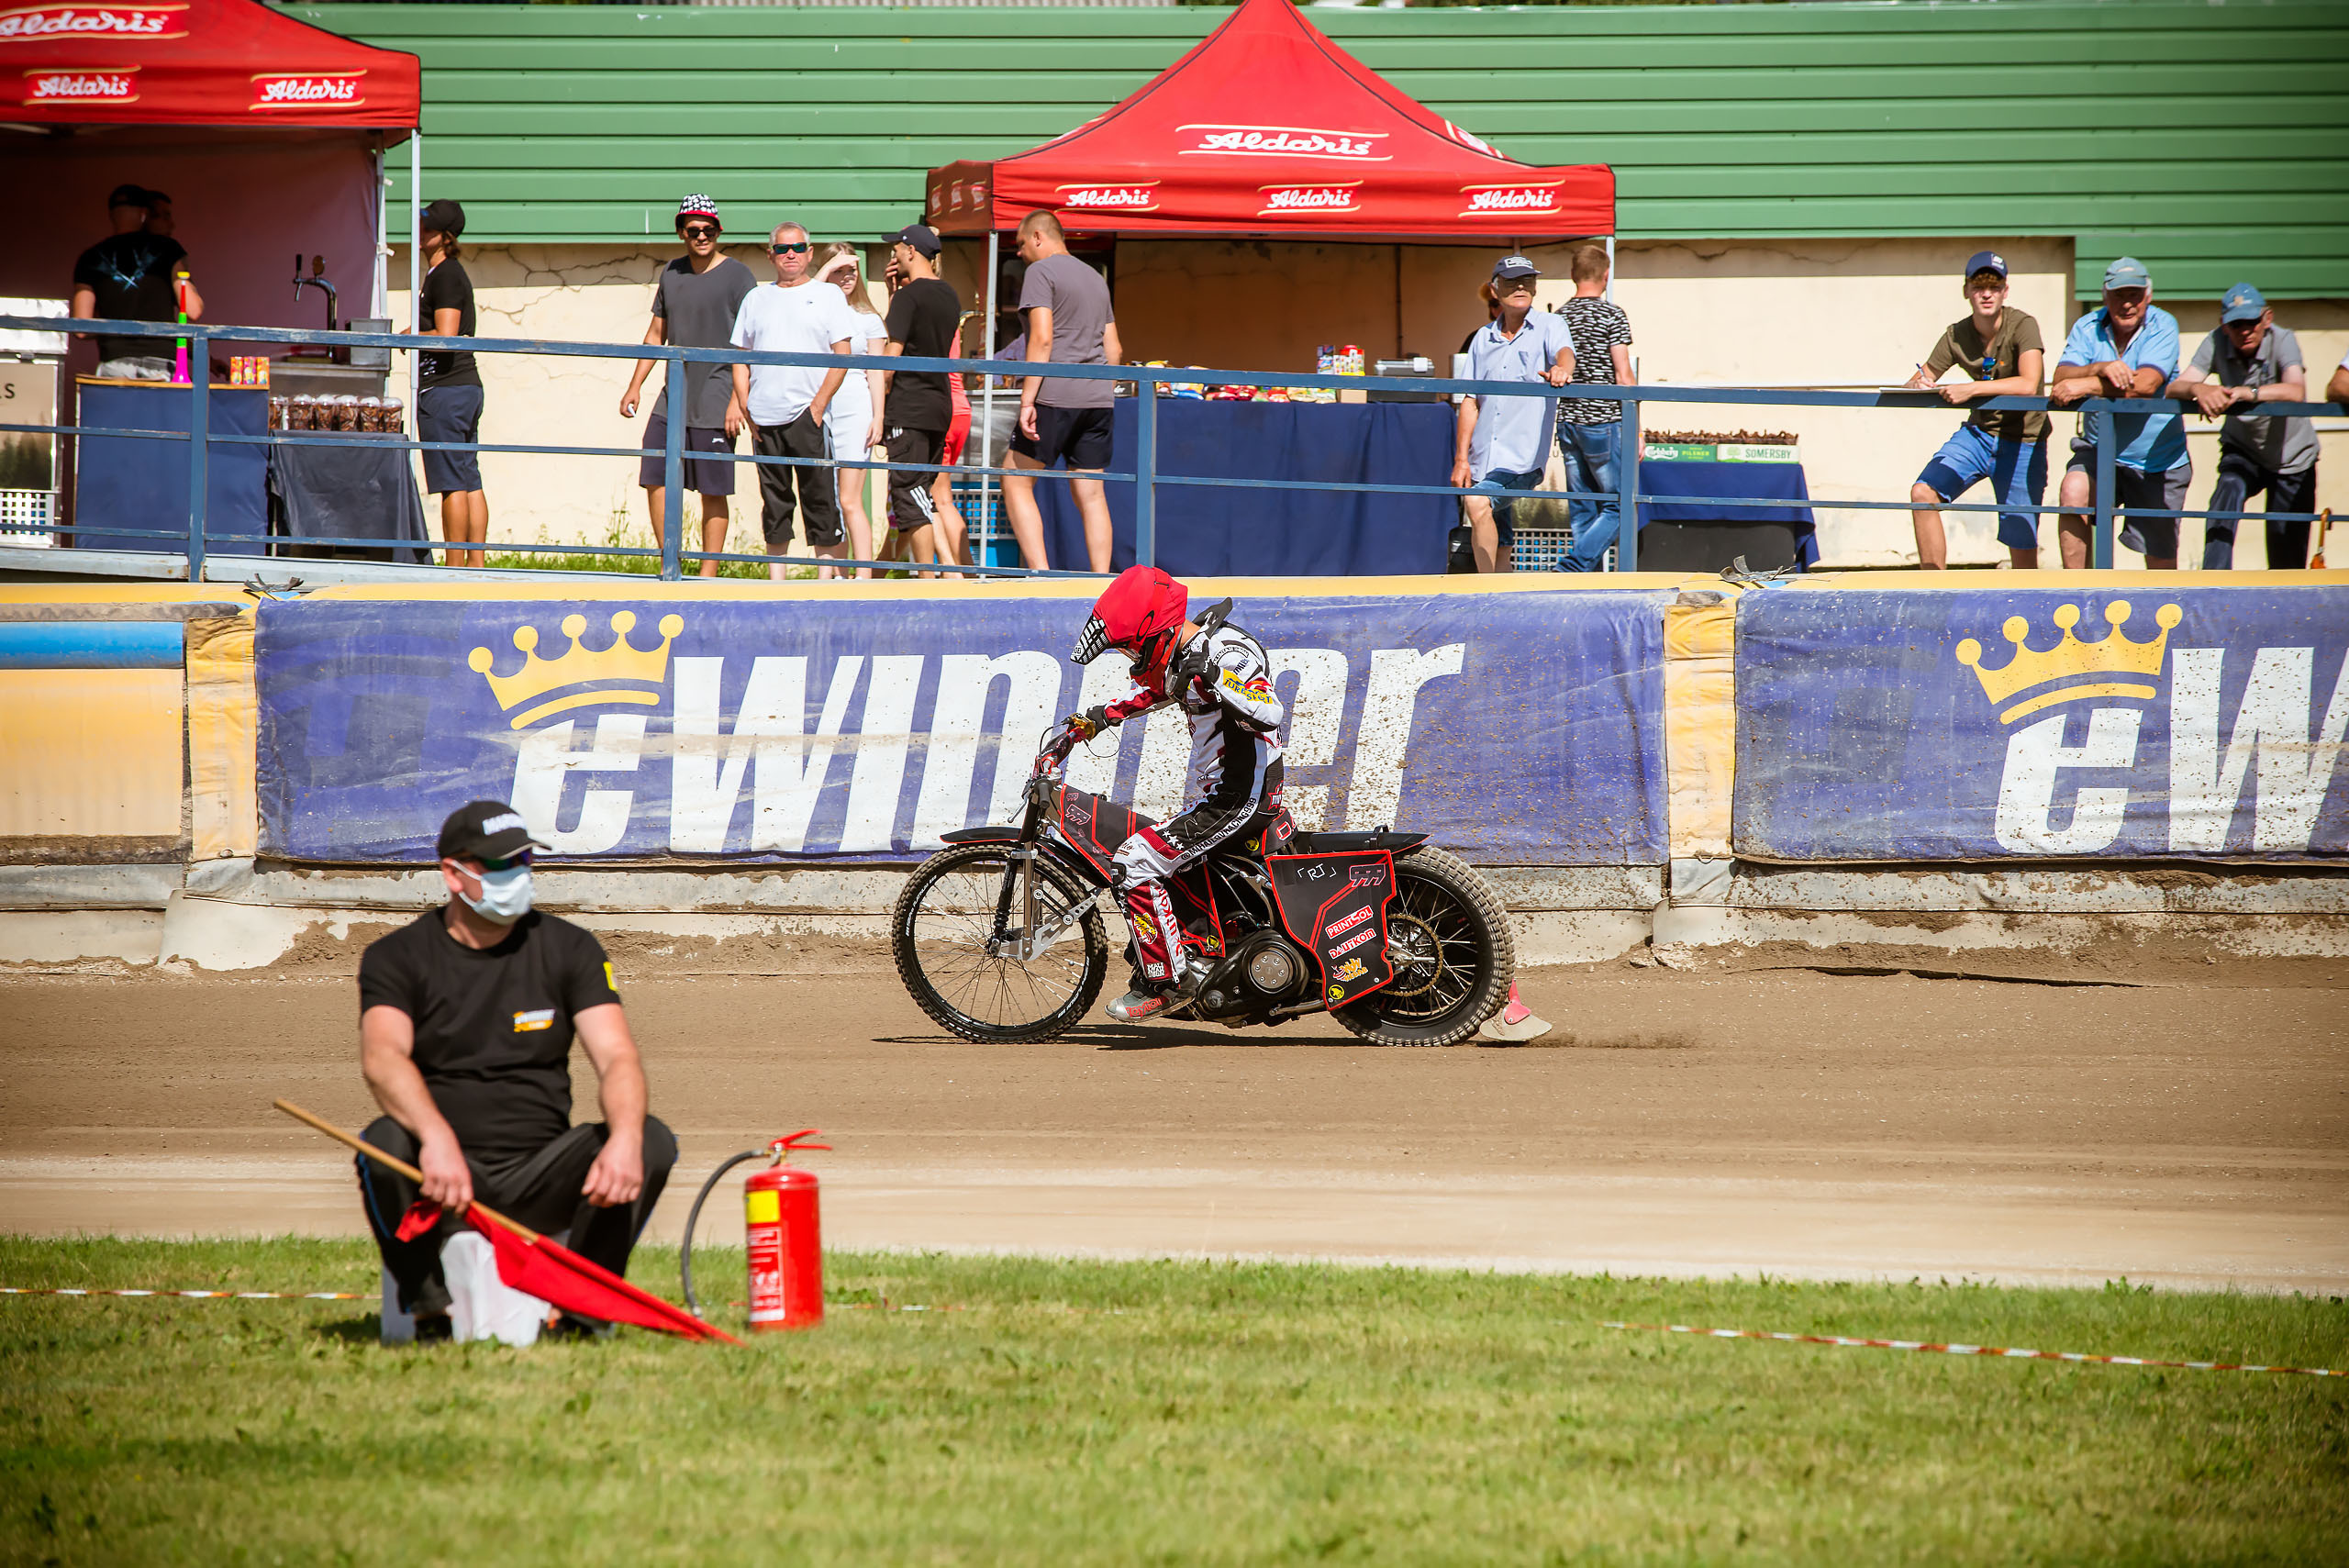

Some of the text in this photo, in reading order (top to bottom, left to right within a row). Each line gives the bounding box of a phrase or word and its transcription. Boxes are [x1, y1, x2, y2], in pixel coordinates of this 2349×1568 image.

[33, 74, 128, 97] Aldaris
[261, 79, 354, 101] Aldaris
[1198, 132, 1370, 155] Aldaris
[1065, 189, 1149, 206] Aldaris
[1266, 189, 1351, 208] Aldaris
[1468, 189, 1553, 210] Aldaris
[1745, 448, 1791, 459] SOMERSBY
[1327, 906, 1373, 937] PRINTSOL
